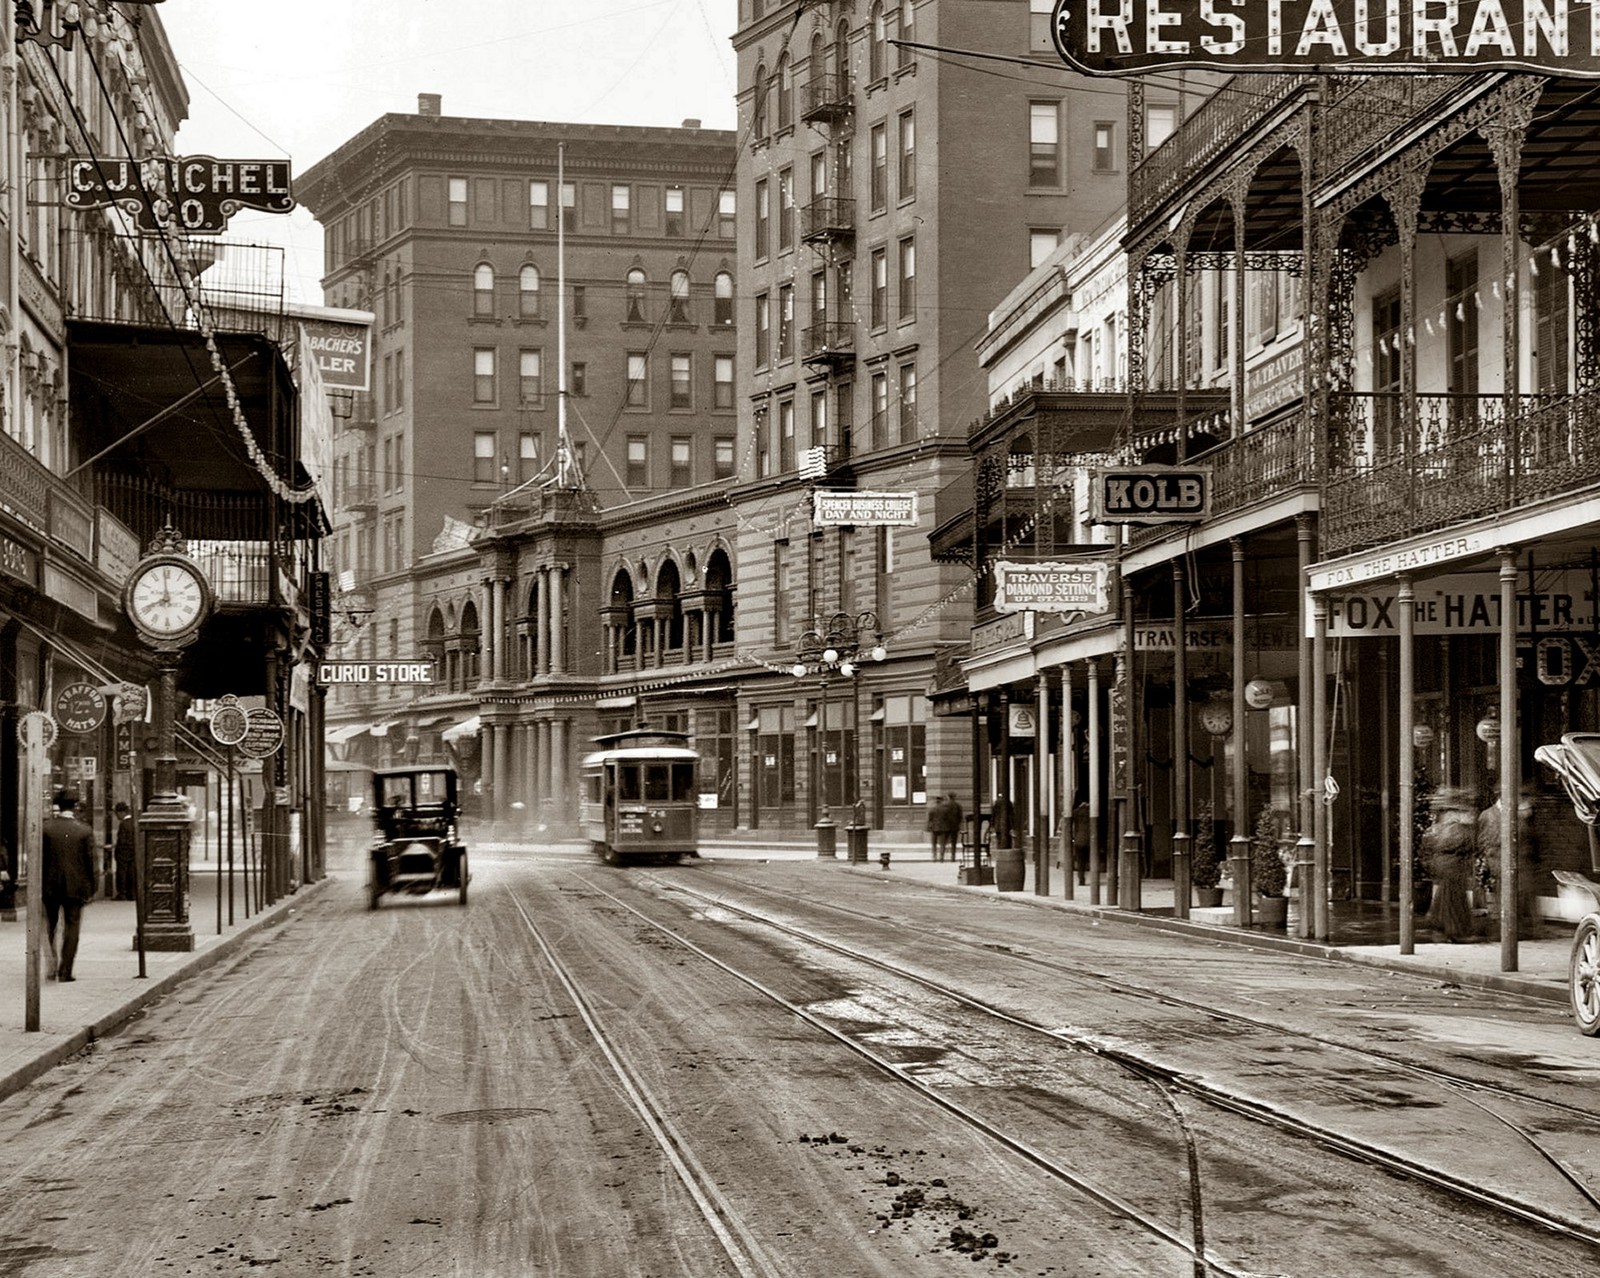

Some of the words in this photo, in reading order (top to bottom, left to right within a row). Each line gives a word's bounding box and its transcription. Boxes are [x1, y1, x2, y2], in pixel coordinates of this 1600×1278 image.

[140, 163, 288, 194] MICHEL
[152, 199, 213, 229] CO.
[310, 336, 363, 355] BACHER'S
[319, 356, 356, 373] LER
[1262, 347, 1304, 384] TRAVER
[1107, 479, 1202, 509] KOLB
[825, 510, 846, 520] DAY
[849, 510, 872, 520] AND
[875, 510, 909, 520] NIGHT
[1008, 573, 1093, 583] TRAVERSE
[1327, 567, 1354, 586] FOX
[1364, 558, 1391, 577] THE
[1006, 583, 1053, 596] DIAMOND
[1055, 583, 1096, 596] SETTING
[1328, 595, 1395, 630] FOX
[1414, 601, 1438, 623] HE
[1251, 631, 1299, 647] JEWE
[320, 664, 370, 682] CURIO
[376, 664, 432, 682] STORE
[65, 717, 97, 729] HATS
[118, 726, 131, 765] AMS
